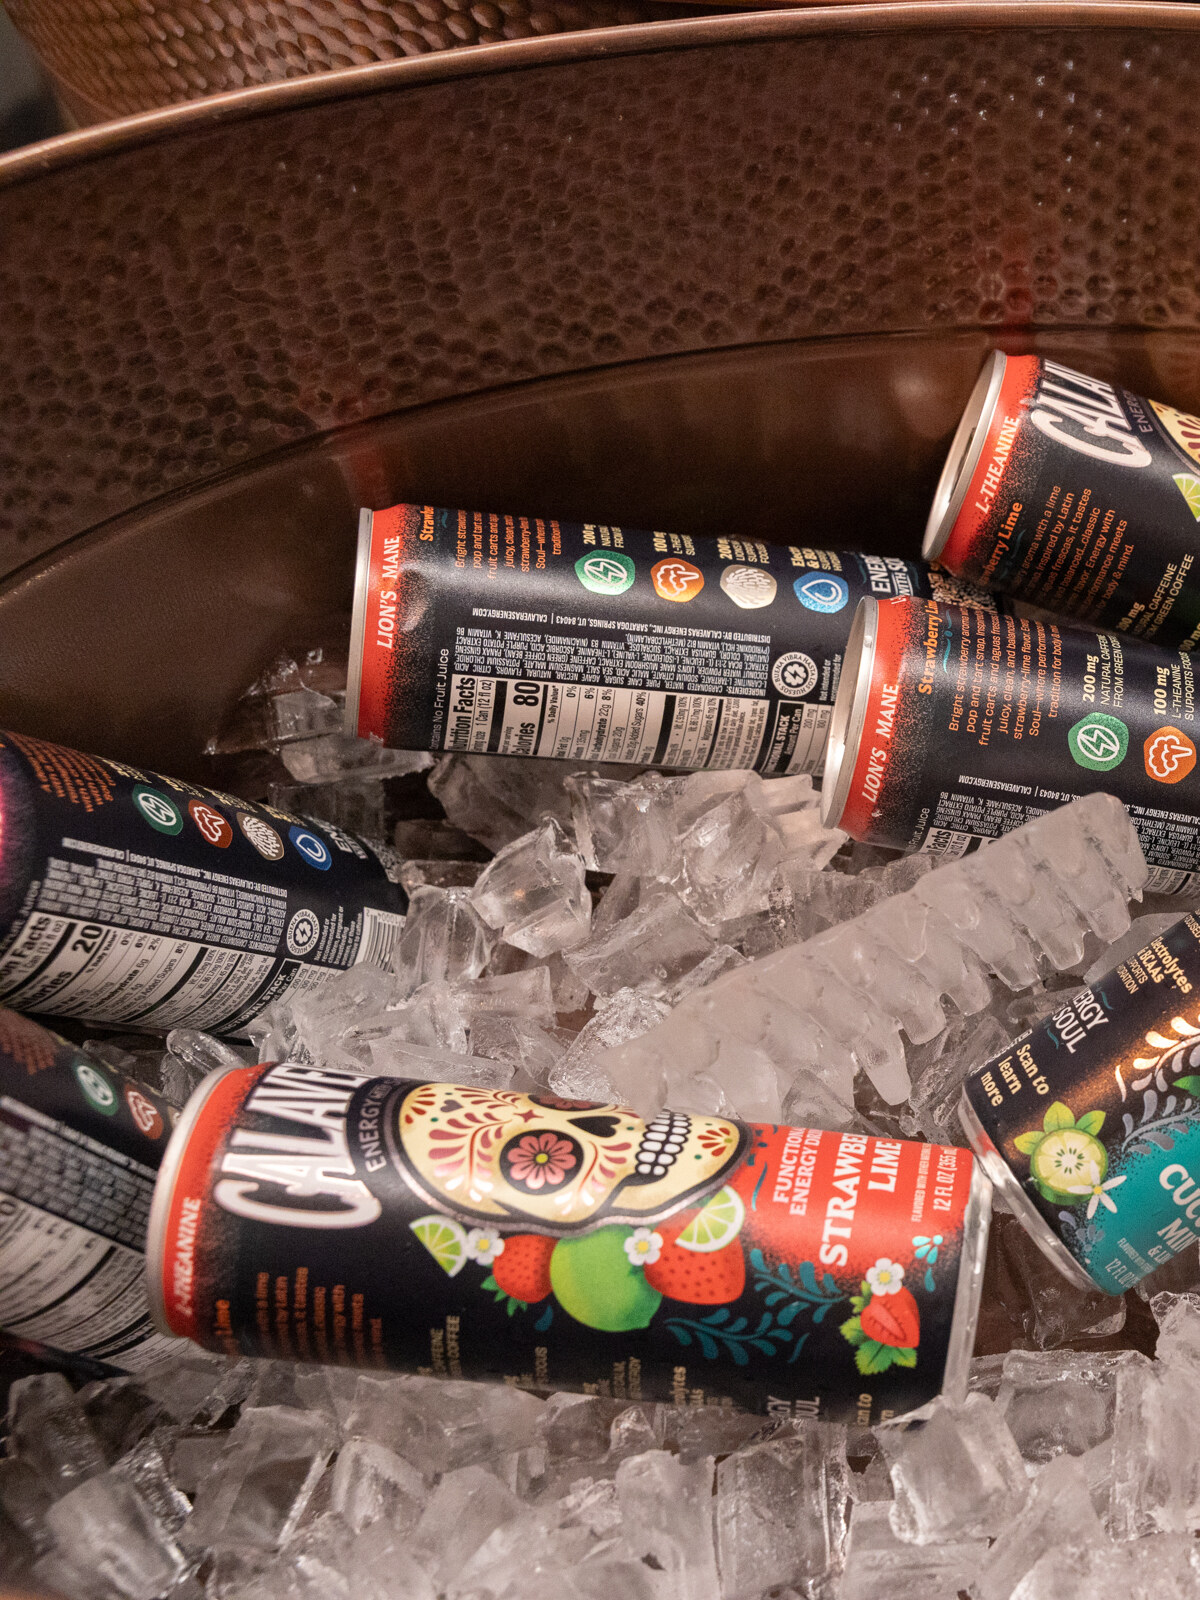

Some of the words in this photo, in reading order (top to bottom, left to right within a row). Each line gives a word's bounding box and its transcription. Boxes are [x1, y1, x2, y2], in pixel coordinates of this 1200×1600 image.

[976, 416, 1022, 512] L-THEANINE
[998, 502, 1023, 539] Lime
[1034, 518, 1049, 541] with
[1045, 485, 1061, 508] lime
[1057, 492, 1074, 519] Latin
[1072, 488, 1092, 523] tastes
[1051, 520, 1065, 534] by
[1085, 533, 1107, 568] Energy
[1100, 509, 1115, 533] with
[1109, 519, 1127, 553] meets
[381, 536, 399, 579] MANE
[1148, 563, 1177, 610] CAFFEINE
[1169, 553, 1194, 596] COFFEE
[376, 590, 397, 648] LION'S
[472, 607, 547, 622] CALAVERASENERGY.COM
[555, 615, 576, 625] 84043
[587, 618, 616, 629] SPRINGS,
[616, 621, 648, 632] SARATOGA
[663, 625, 687, 636] ENERGY
[687, 628, 722, 639] CALAVERAS
[722, 631, 732, 640] BY:
[732, 632, 771, 643] DISTRIBUTED
[436, 648, 449, 680] Juice
[916, 614, 941, 694] Strawberry
[954, 637, 971, 692] strawberry
[1086, 654, 1099, 673] mg
[726, 685, 766, 696] INGREDIENTS:
[1081, 674, 1096, 703] 200
[1156, 665, 1170, 686] mg
[433, 681, 447, 708] Fruit
[452, 677, 477, 715] Facts
[512, 677, 543, 707] 80
[565, 685, 577, 698] 0%
[583, 687, 595, 700] 6%
[600, 688, 612, 701] 8%
[635, 691, 646, 706] 40%
[970, 682, 983, 707] and
[983, 684, 997, 717] carts
[1153, 688, 1167, 715] 100
[432, 709, 444, 723] No
[791, 708, 804, 722] Can
[948, 693, 964, 731] Bright
[966, 709, 978, 733] pop
[775, 714, 790, 741] STACK
[862, 747, 886, 802] LION'S
[875, 683, 899, 738] MANE
[978, 718, 992, 746] fruit
[10, 914, 52, 958] Facts
[66, 920, 103, 956] 20
[261, 972, 286, 1002] STACK
[1052, 1004, 1086, 1053] SOUL
[998, 1055, 1021, 1094] learn
[1016, 1043, 1038, 1078] Scan
[1032, 1071, 1051, 1099] to
[980, 1071, 1003, 1106] more
[213, 1062, 382, 1227] CALAVE
[360, 1107, 390, 1176] ENERGY
[789, 1147, 816, 1216] ENERGY
[868, 1141, 901, 1192] LIME
[936, 1167, 955, 1184] OZ
[818, 1132, 868, 1267] STRAWBE
[932, 1197, 952, 1211] 12
[934, 1185, 953, 1197] FL
